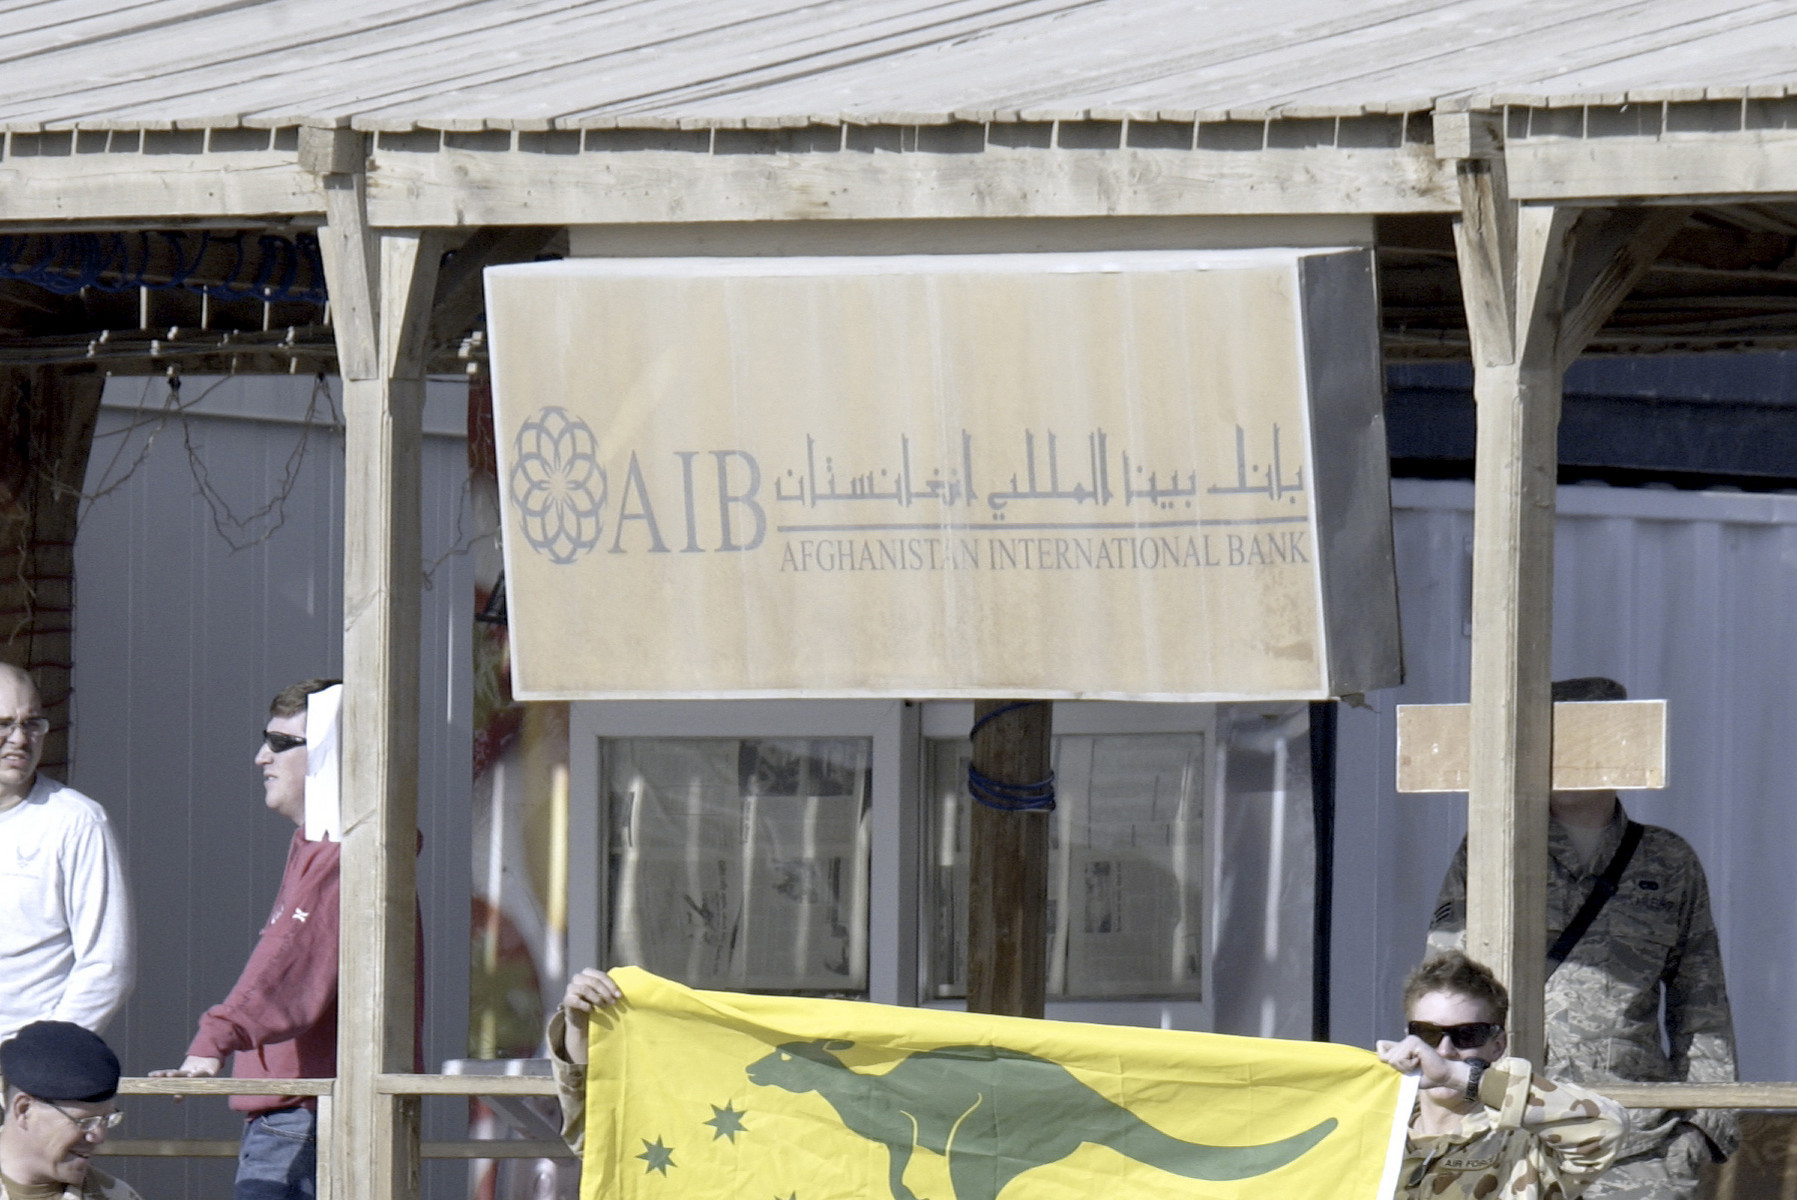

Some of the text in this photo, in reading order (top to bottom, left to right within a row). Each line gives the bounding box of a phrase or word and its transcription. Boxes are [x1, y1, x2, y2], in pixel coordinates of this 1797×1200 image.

[607, 449, 767, 553] AIB
[779, 530, 1311, 572] AFGHANISTAN INTERNATIONAL BANK
